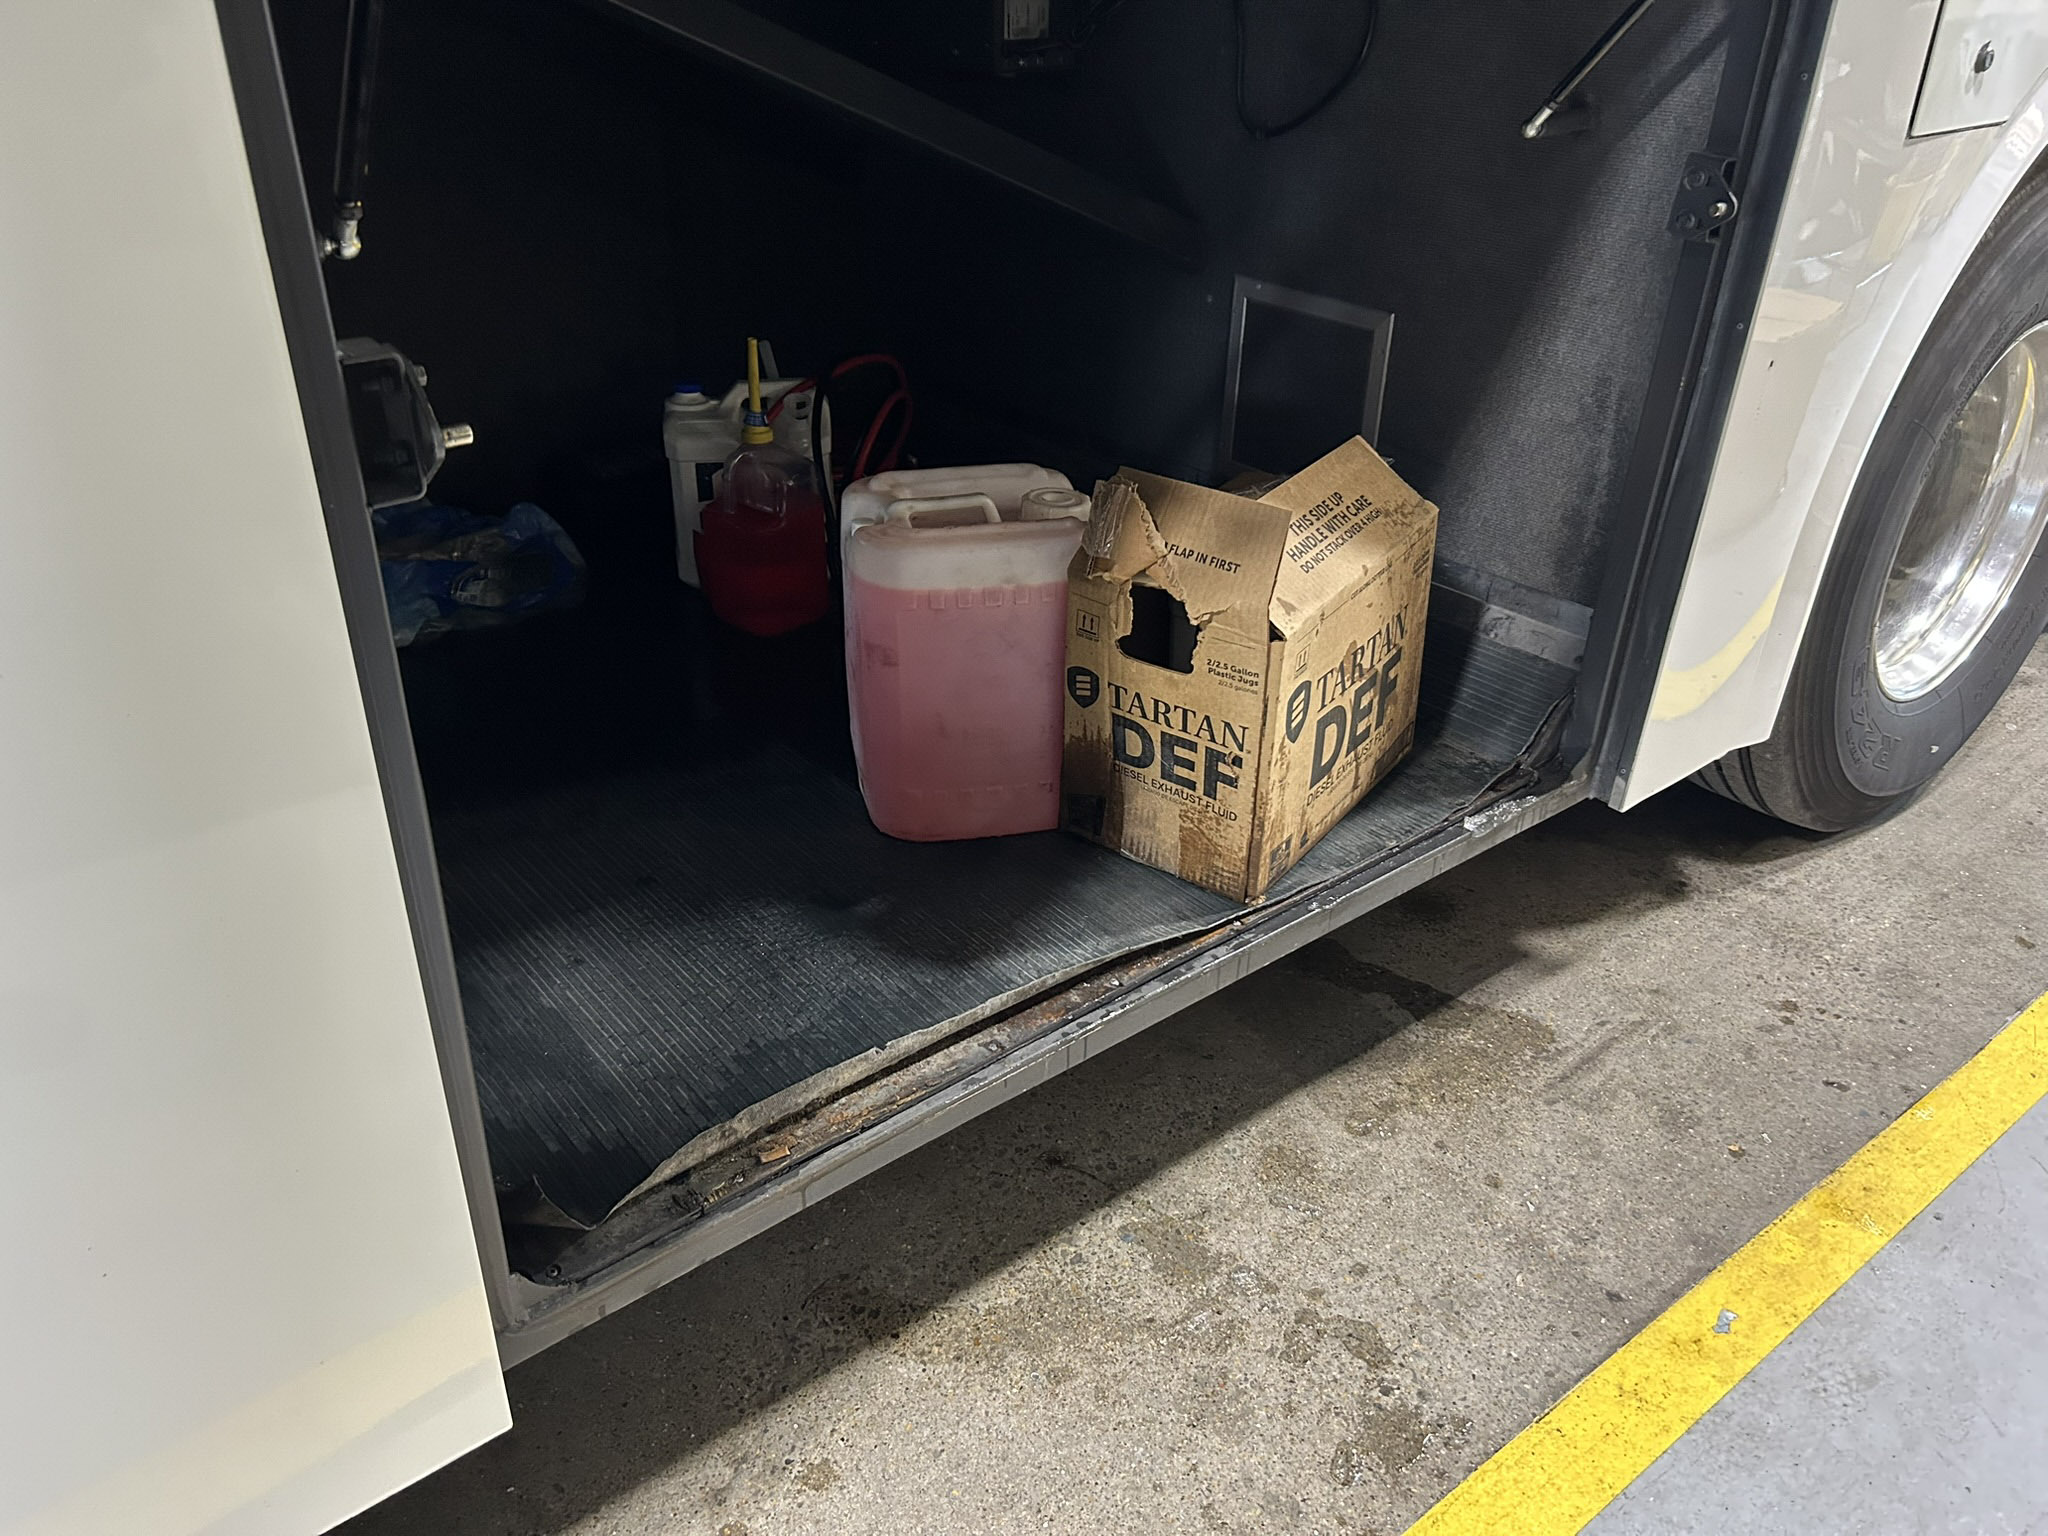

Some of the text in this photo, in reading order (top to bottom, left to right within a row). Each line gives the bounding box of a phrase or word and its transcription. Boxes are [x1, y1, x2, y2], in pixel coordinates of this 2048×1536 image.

[1286, 494, 1373, 563] HANDLE WITH CARE
[1290, 491, 1344, 537] THIS SIDE UP
[1300, 507, 1383, 574] DO NOT STACK OVER 4 HIGH
[1168, 543, 1195, 560] FLAP
[1194, 551, 1209, 565] IN
[1208, 556, 1241, 574] FIRST
[1206, 658, 1260, 679] 2/2.5 Gallon
[1207, 666, 1259, 688] Plastic Jugs
[1316, 603, 1409, 714] TARTAN
[1107, 681, 1249, 753] TARTAN
[1309, 645, 1403, 791] DEF
[1111, 711, 1244, 801] DEF
[1112, 762, 1149, 786] DIESEL
[1150, 777, 1203, 807] EXHAUST
[1204, 800, 1238, 822] FLUID
[1306, 771, 1335, 807] DIESEL
